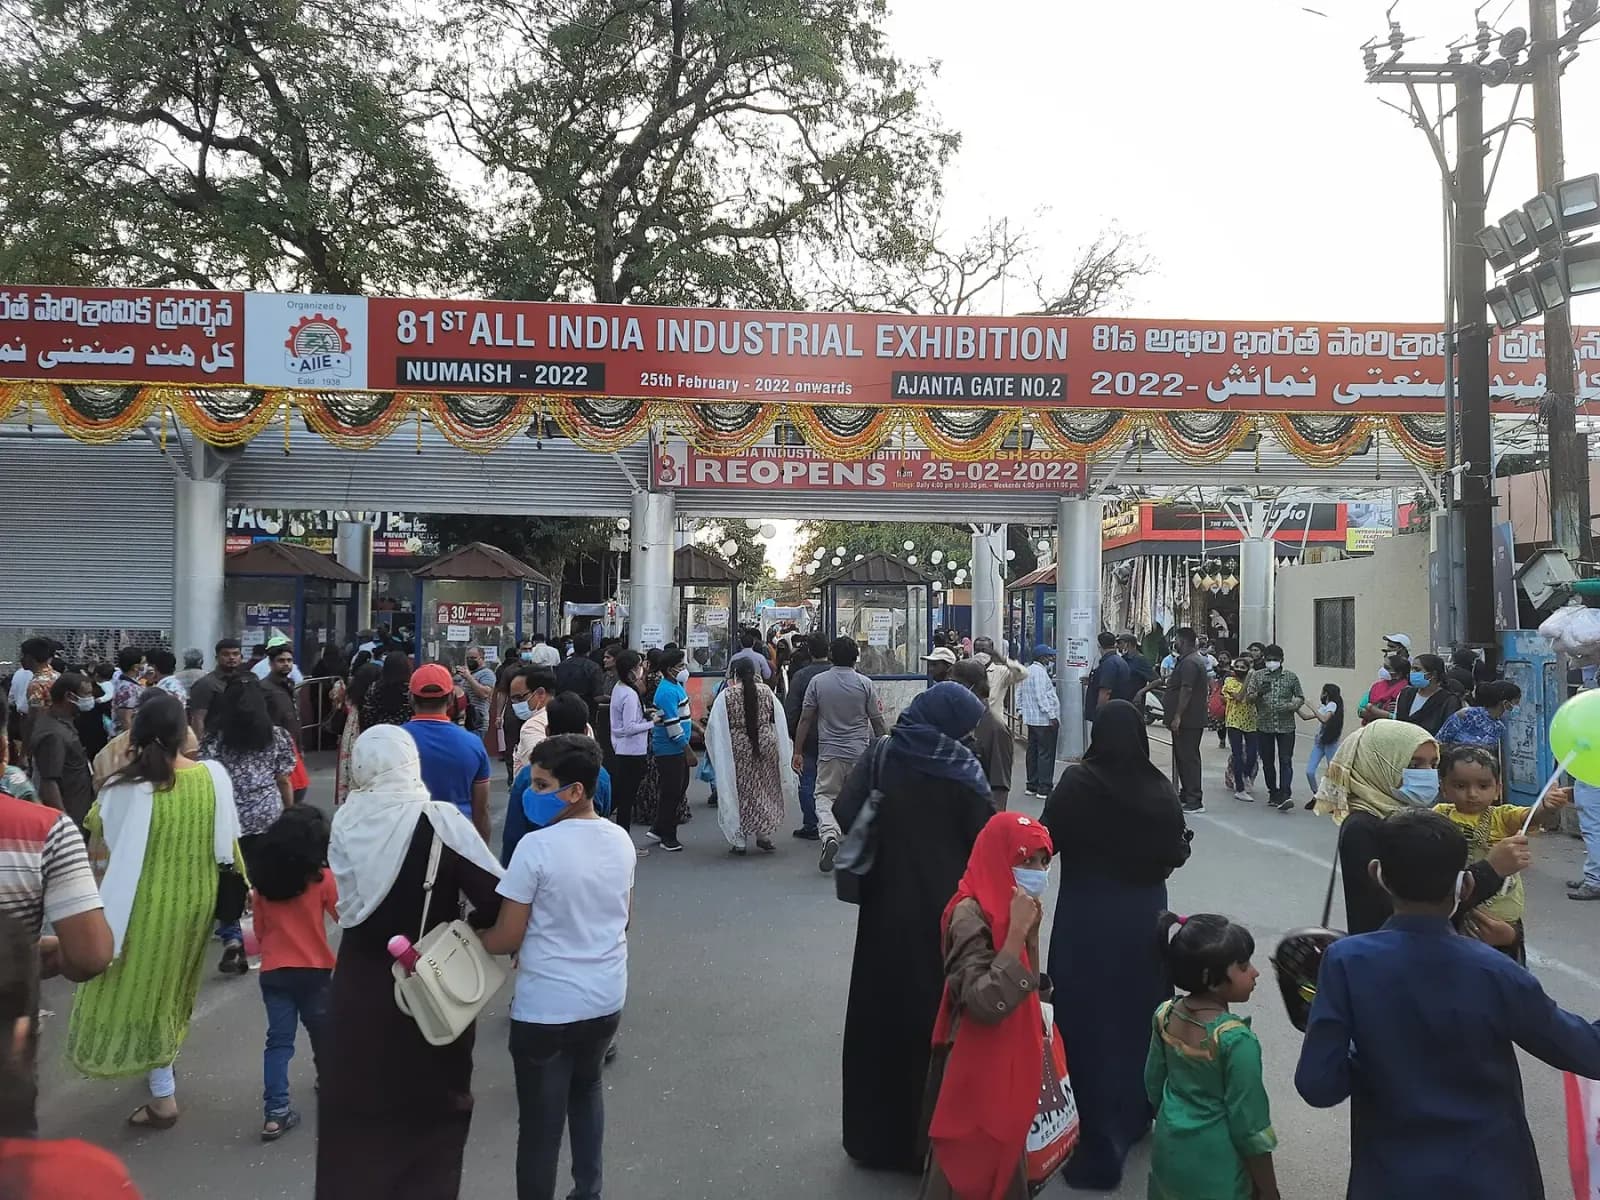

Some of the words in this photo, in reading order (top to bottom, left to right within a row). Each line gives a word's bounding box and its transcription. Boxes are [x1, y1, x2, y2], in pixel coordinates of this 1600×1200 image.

[286, 300, 334, 311] Organized
[336, 302, 347, 311] by
[469, 312, 536, 347] ALL
[548, 315, 644, 350] INDIA
[657, 318, 863, 356] INDUSTRIAL
[876, 324, 1067, 361] EXHIBITION
[406, 361, 511, 384] NUMAISH
[535, 365, 588, 386] 2022
[640, 373, 672, 387] 25th
[678, 374, 739, 393] February
[755, 378, 789, 393] 2022
[795, 381, 852, 395] onwards
[898, 375, 964, 396] AJANTA
[971, 377, 1014, 397] GATE
[1021, 378, 1061, 397] NO.2
[695, 459, 886, 486] REOPENS
[922, 462, 1078, 480] 25-02-2022
